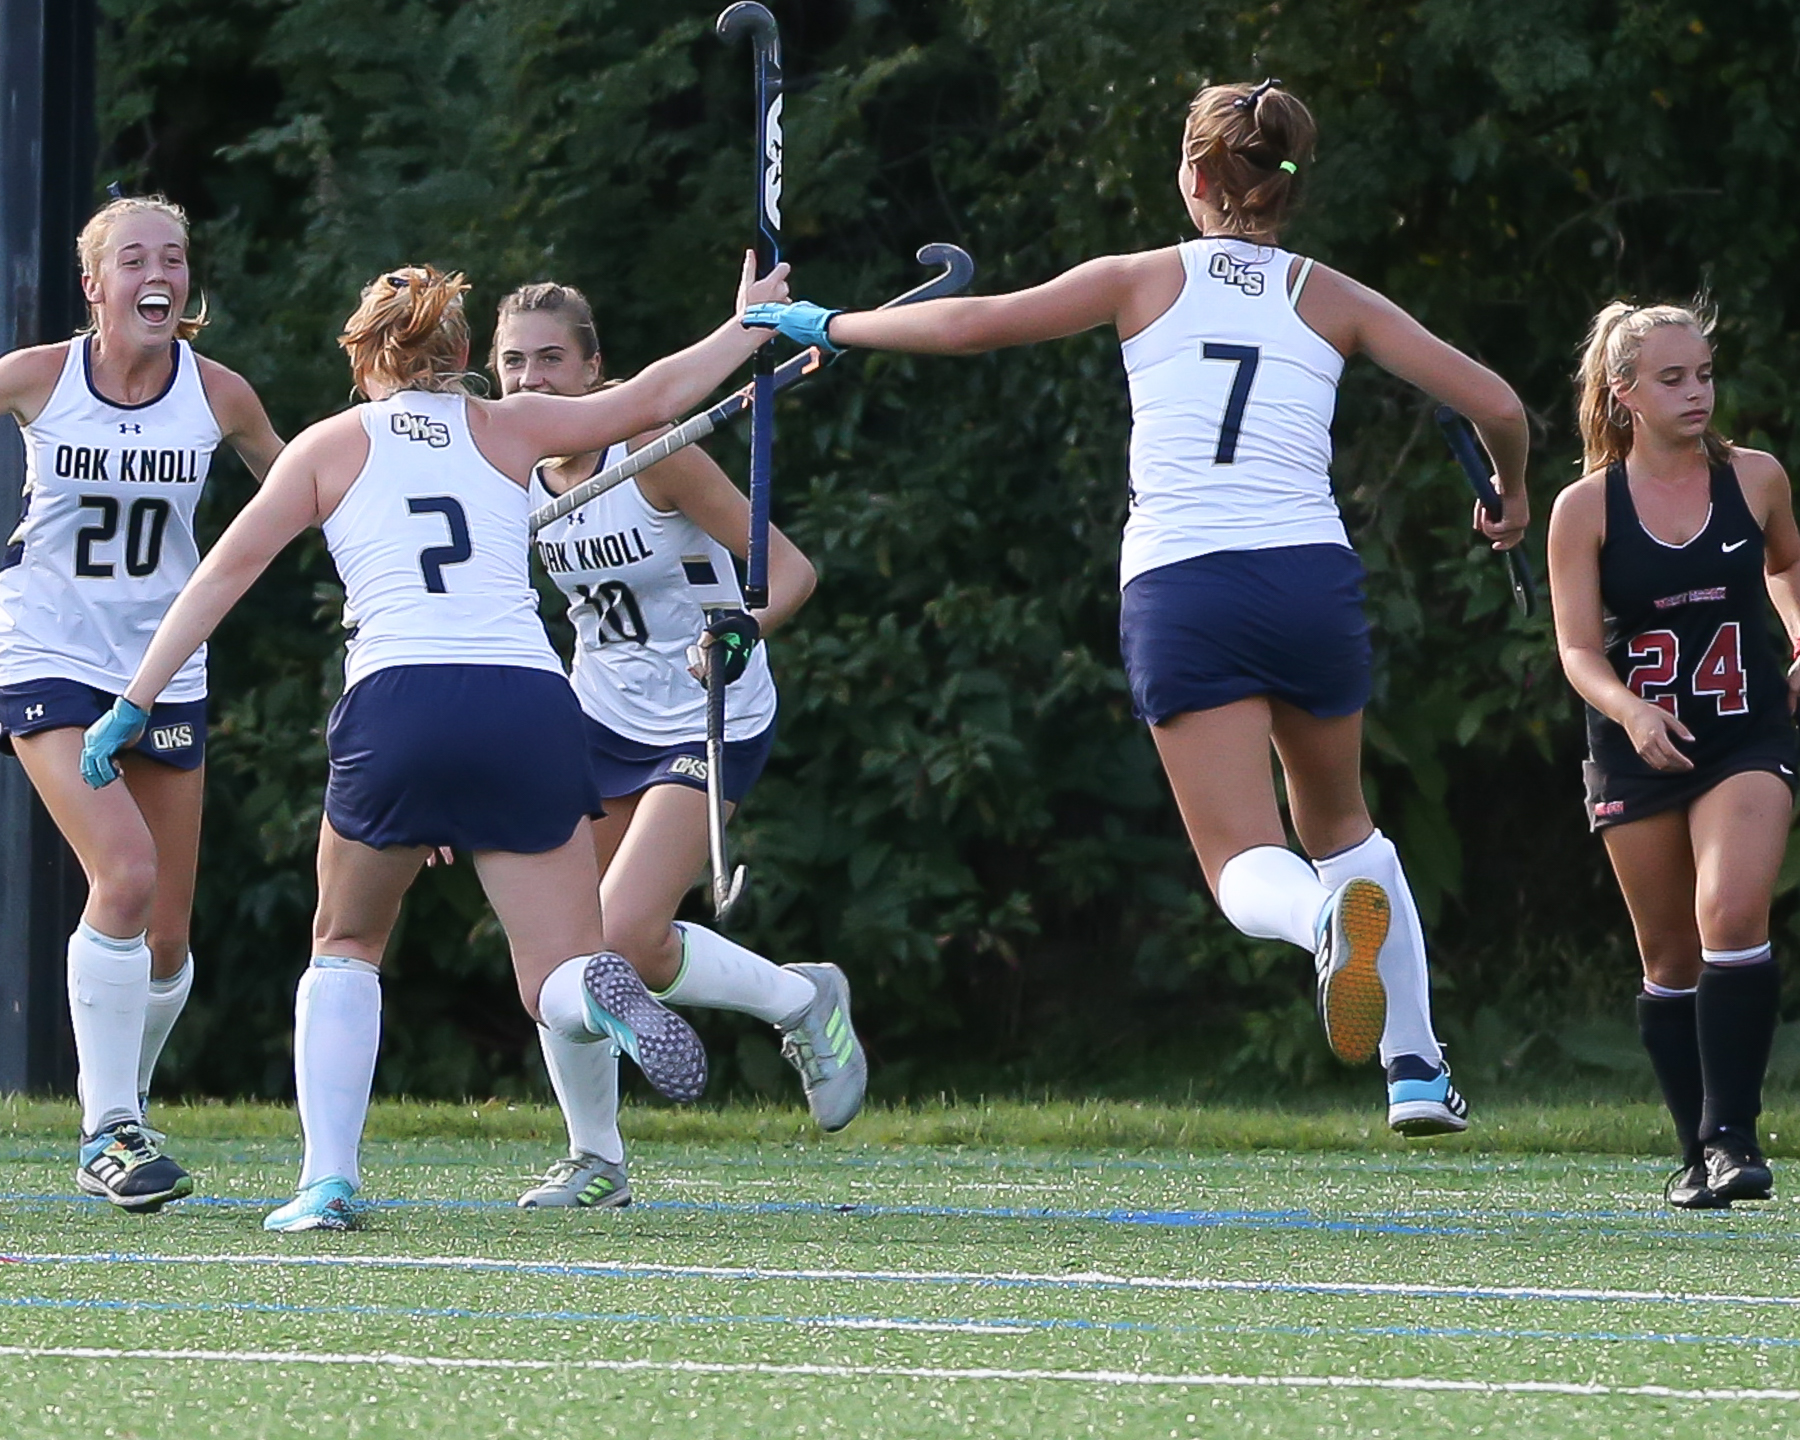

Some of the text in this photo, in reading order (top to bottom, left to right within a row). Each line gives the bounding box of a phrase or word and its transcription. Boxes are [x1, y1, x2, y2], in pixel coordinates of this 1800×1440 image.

[1209, 252, 1265, 297] OKS
[1201, 341, 1262, 466] 7
[390, 412, 451, 448] OKS
[54, 444, 198, 484] OAK KNOLL
[74, 494, 171, 578] 20
[574, 527, 654, 571] KNOLL
[573, 579, 650, 647] 10
[1626, 621, 1750, 719] 24
[153, 725, 193, 750] OKS
[670, 755, 708, 781] OKS
